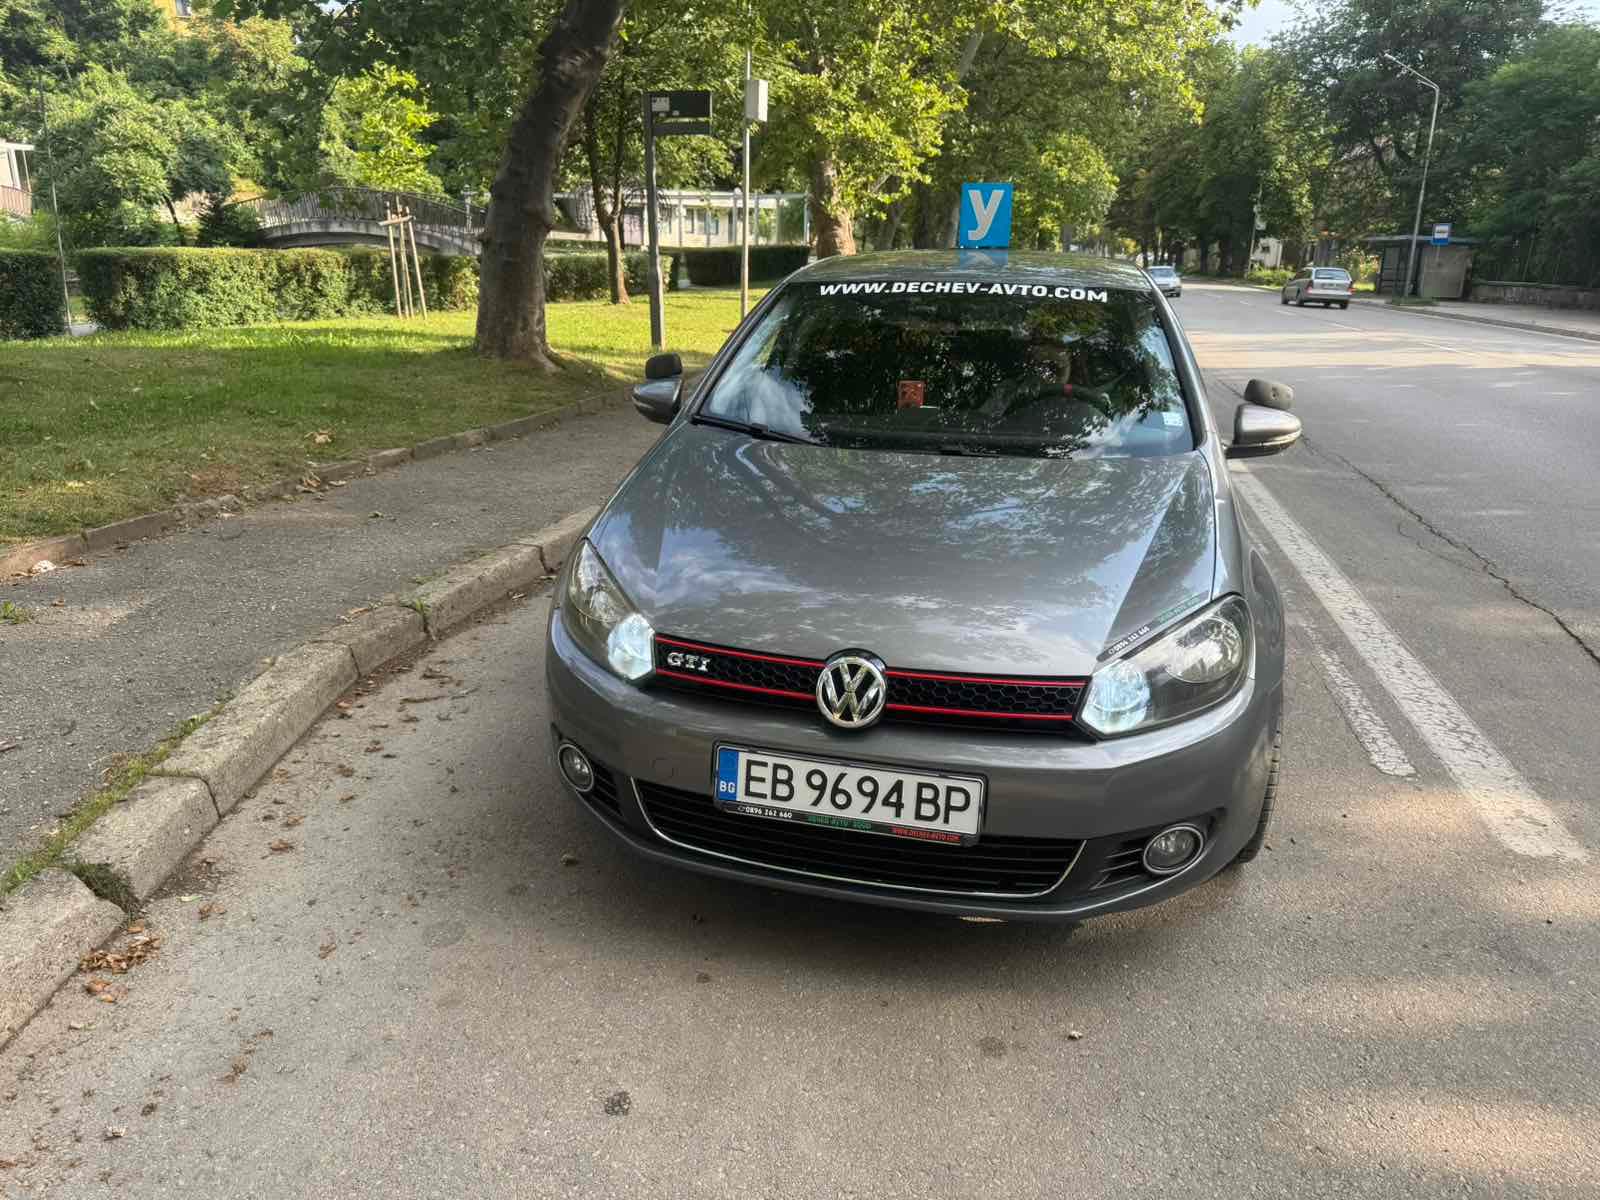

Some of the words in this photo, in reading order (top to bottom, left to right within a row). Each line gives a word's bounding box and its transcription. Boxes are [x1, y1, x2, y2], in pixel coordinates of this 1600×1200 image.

[820, 281, 1108, 303] WWW.DECHEV-AVTO.COM
[667, 652, 711, 672] GTI
[816, 656, 887, 728] VW
[718, 780, 736, 793] BG
[744, 759, 795, 802] EB
[805, 768, 905, 818] 9694
[914, 782, 971, 825] BP
